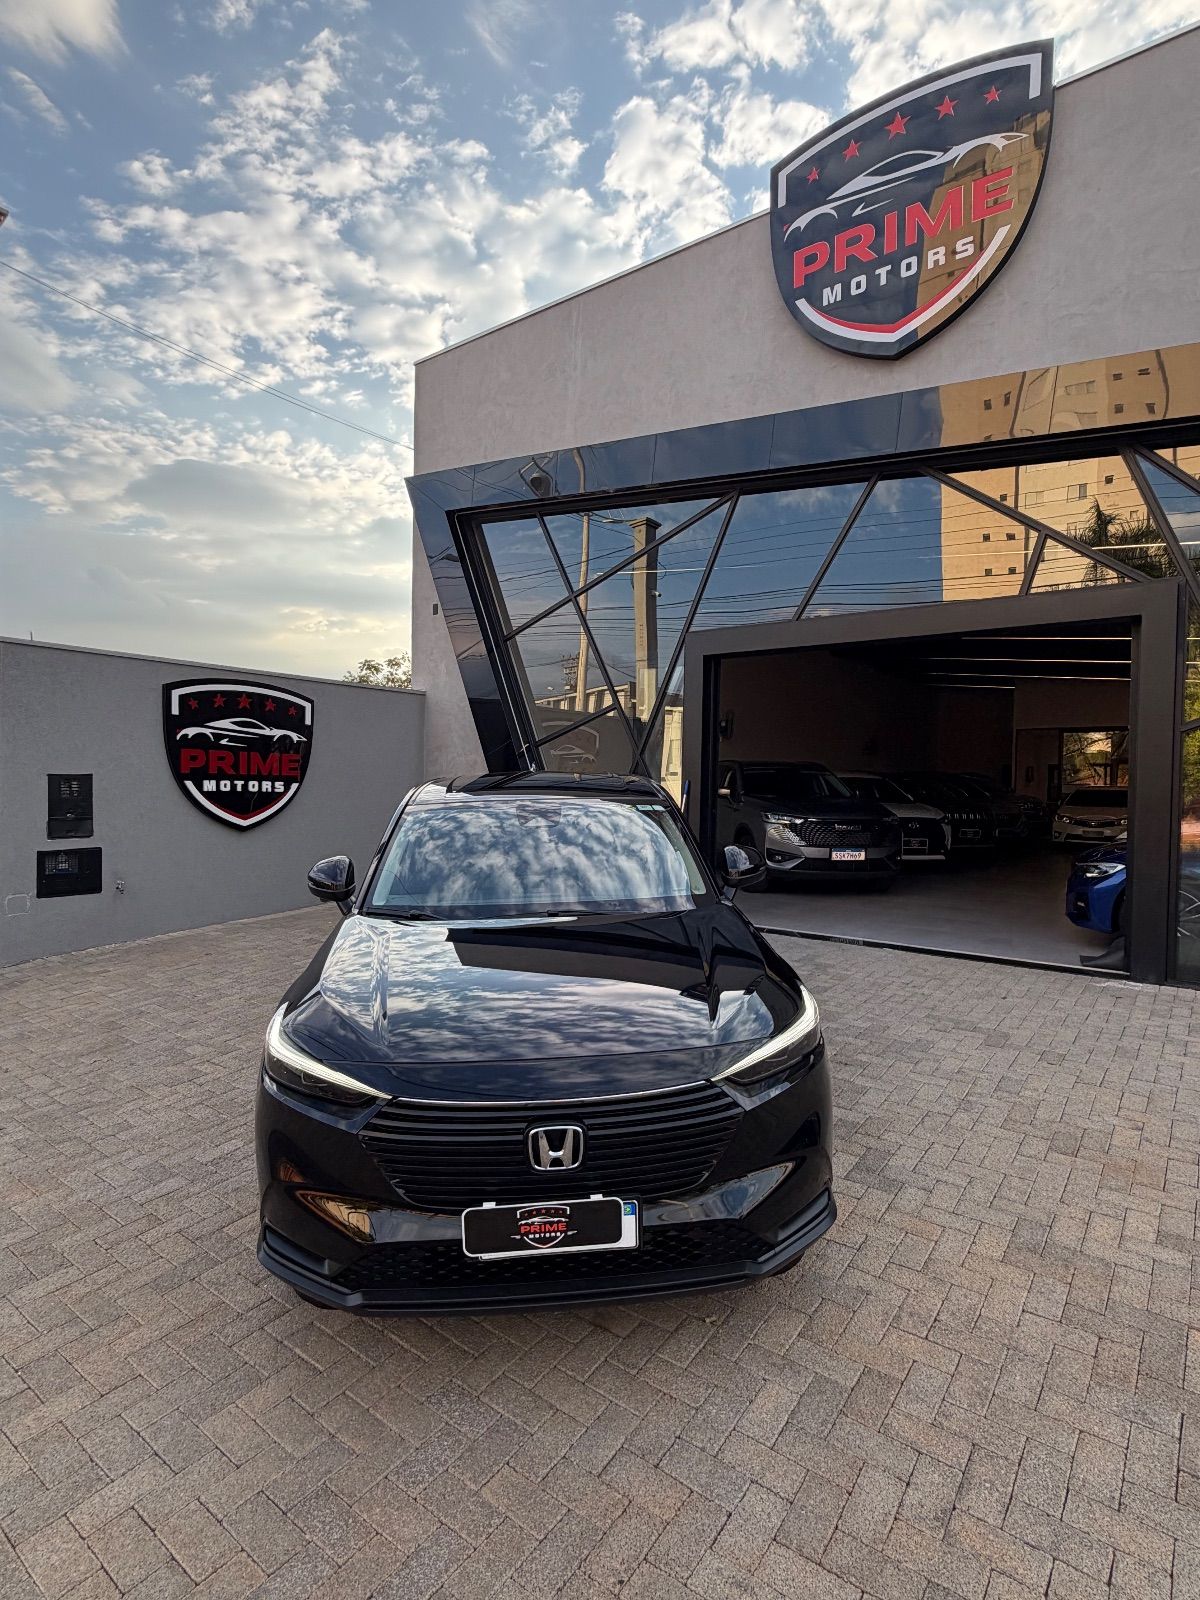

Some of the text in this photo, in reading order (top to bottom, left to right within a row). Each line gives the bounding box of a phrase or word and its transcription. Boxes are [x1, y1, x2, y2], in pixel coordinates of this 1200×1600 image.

[793, 165, 1014, 289] PRIME
[822, 236, 975, 307] MOTORS
[180, 748, 300, 776] PRIME
[203, 780, 285, 792] MOTORS
[520, 1222, 567, 1234] PRIME
[528, 1231, 561, 1239] MOTORS
